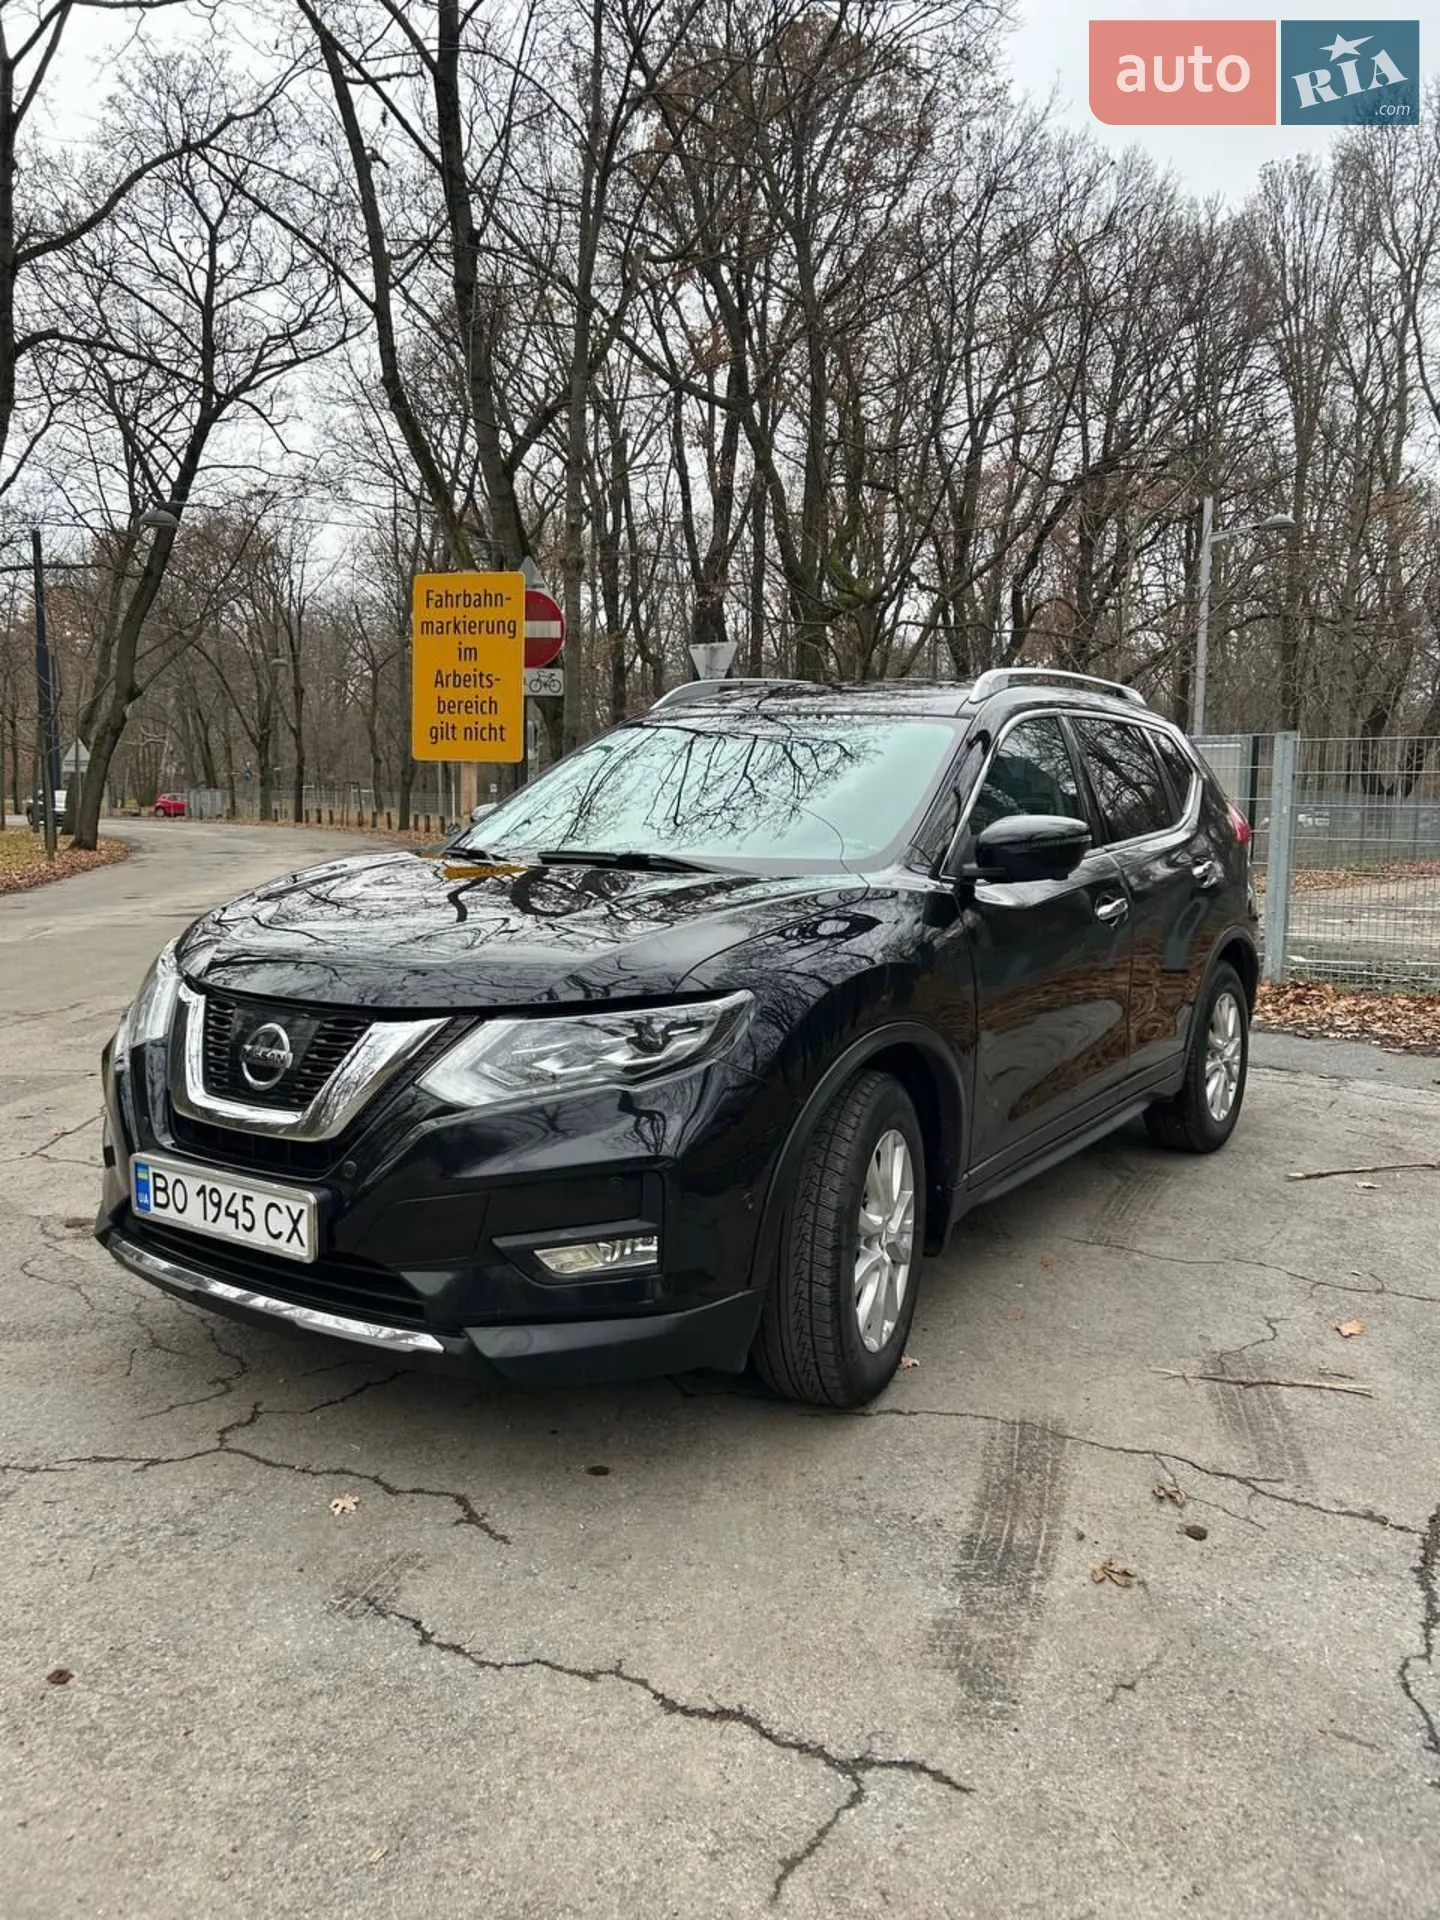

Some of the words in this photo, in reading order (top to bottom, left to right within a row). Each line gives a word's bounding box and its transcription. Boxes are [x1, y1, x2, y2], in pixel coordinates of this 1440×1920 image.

[425, 589, 512, 609] Fahrbahn-
[420, 616, 517, 639] markierung
[457, 641, 478, 662] im
[434, 668, 502, 689] Arbeits-
[436, 695, 498, 715] bereich
[429, 722, 458, 744] gilt
[463, 722, 506, 742] nicht
[152, 1171, 188, 1214] BO
[196, 1184, 256, 1233] 1945
[264, 1201, 306, 1248] CX
